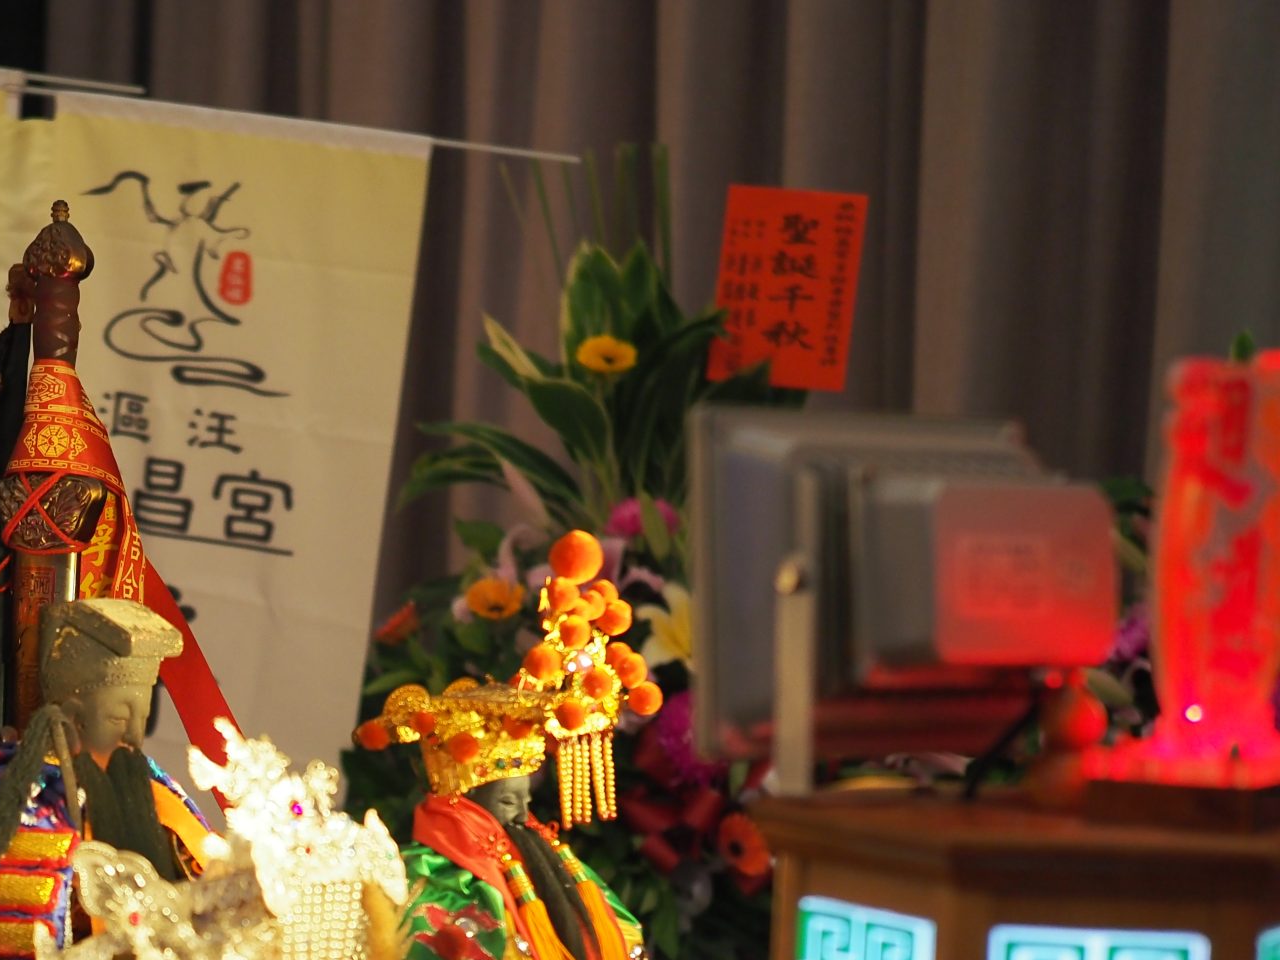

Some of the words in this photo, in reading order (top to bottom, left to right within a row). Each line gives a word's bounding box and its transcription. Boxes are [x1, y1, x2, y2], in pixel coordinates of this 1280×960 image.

[761, 213, 819, 351] 聖誕千秋
[132, 456, 294, 543] 昌宮
